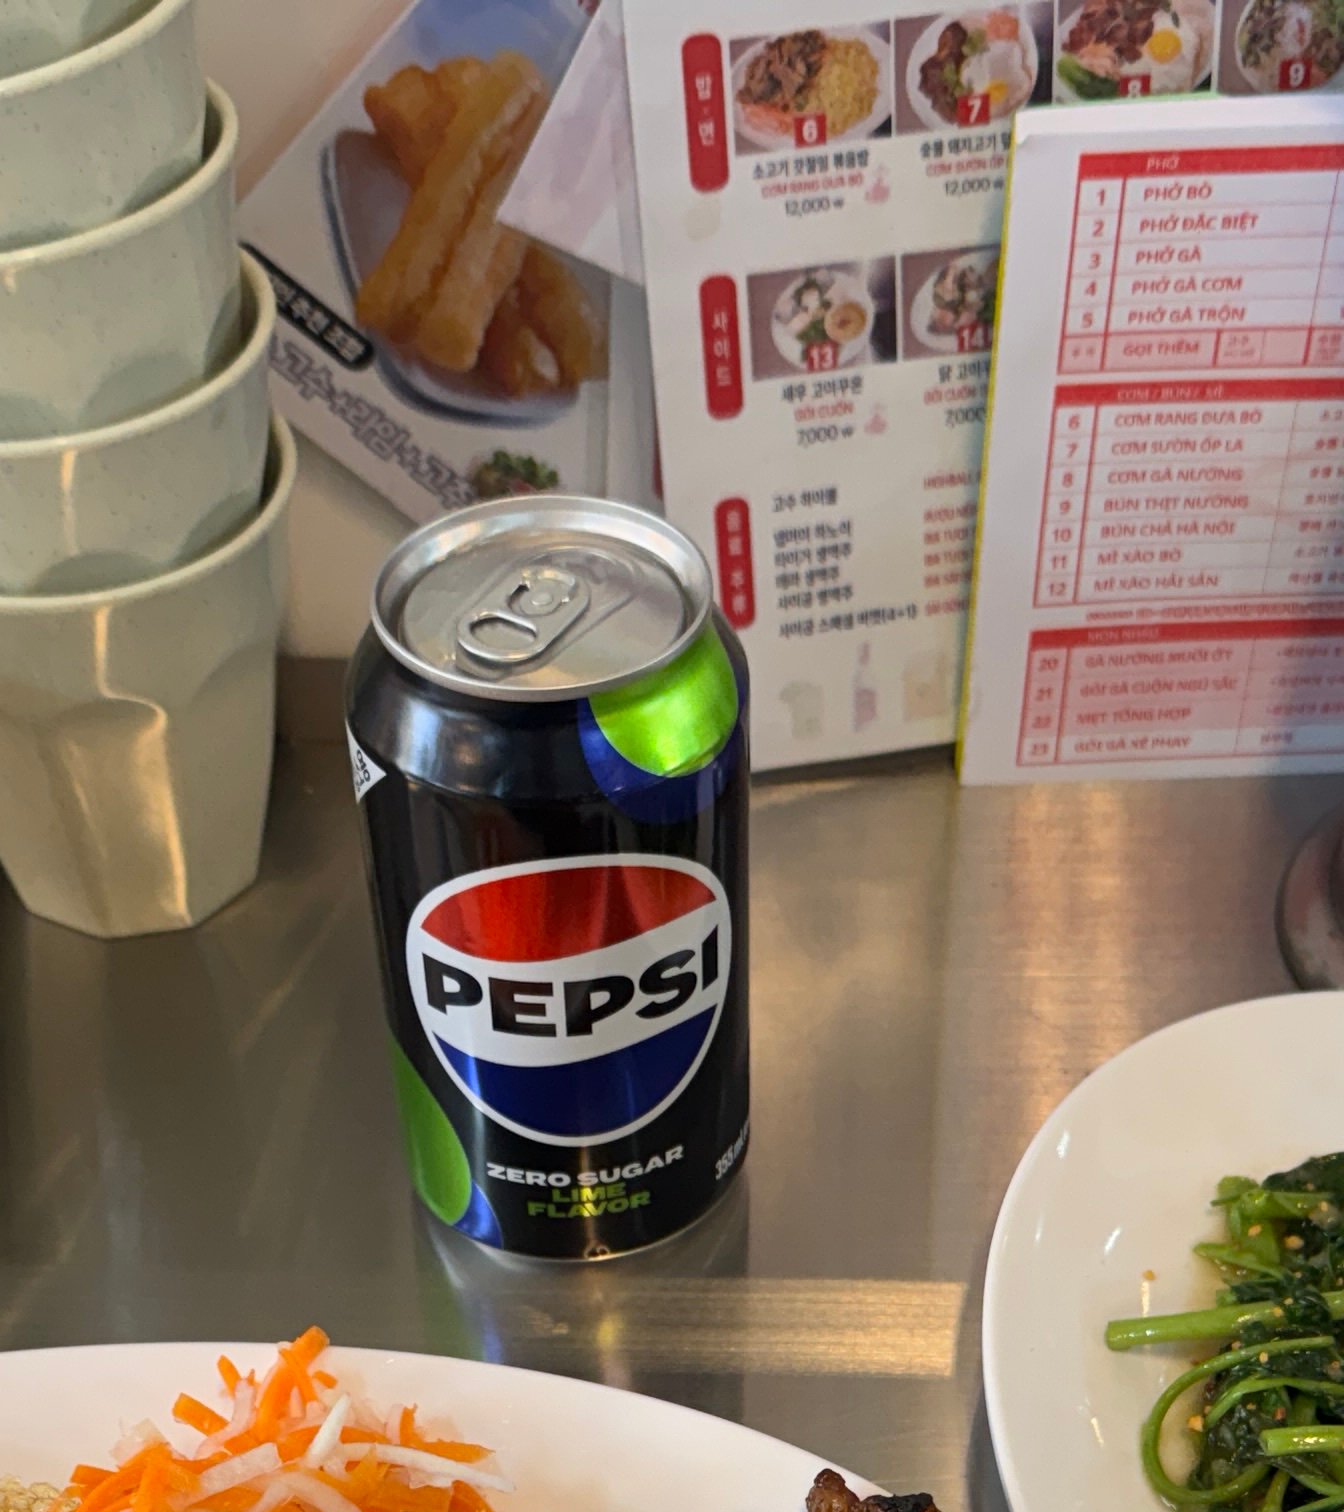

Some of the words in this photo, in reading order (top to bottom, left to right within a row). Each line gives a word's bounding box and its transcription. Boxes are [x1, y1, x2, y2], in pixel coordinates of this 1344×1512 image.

[1288, 63, 1302, 87] 9
[967, 98, 981, 122] 7
[803, 119, 816, 142] 6
[1096, 189, 1106, 205] 1
[1143, 183, 1183, 200] PHỞ
[1186, 181, 1213, 199] BÒ
[1092, 220, 1104, 237] 2
[1139, 216, 1178, 232] PHỞ
[1182, 213, 1218, 234] ĐẶC
[1221, 213, 1260, 233] BIỆT
[1089, 252, 1101, 269] 3
[1135, 247, 1173, 264] PHỞ
[1178, 245, 1202, 262] GÀ
[1084, 281, 1097, 297] 4
[1131, 278, 1170, 295] PHỞ
[1173, 276, 1197, 293] GÀ
[1201, 275, 1244, 292] CƠM
[1080, 311, 1093, 328] 5
[1128, 307, 1167, 324] PHỞ
[1171, 305, 1195, 322] GÀ
[1199, 304, 1246, 324] TRỘN
[961, 328, 983, 350] 14
[809, 346, 834, 369] 13
[1068, 415, 1080, 430] 6
[1114, 411, 1152, 427] CƠM
[1155, 410, 1197, 427] RANG
[1067, 443, 1077, 459] 7
[1111, 439, 1148, 456] CƠM
[1062, 472, 1074, 488] 8
[1108, 468, 1145, 485] CƠM
[1149, 466, 1173, 484] GÀ
[1059, 499, 1071, 515] 9
[1053, 527, 1072, 543] 10
[1050, 555, 1067, 571] 11
[1047, 582, 1066, 597] 12
[422, 924, 720, 1039] PEPSI
[486, 1162, 572, 1188] ZERO
[577, 1144, 685, 1187] SUGAR
[551, 1181, 627, 1203] LIME
[527, 1190, 652, 1218] FLAVOR
